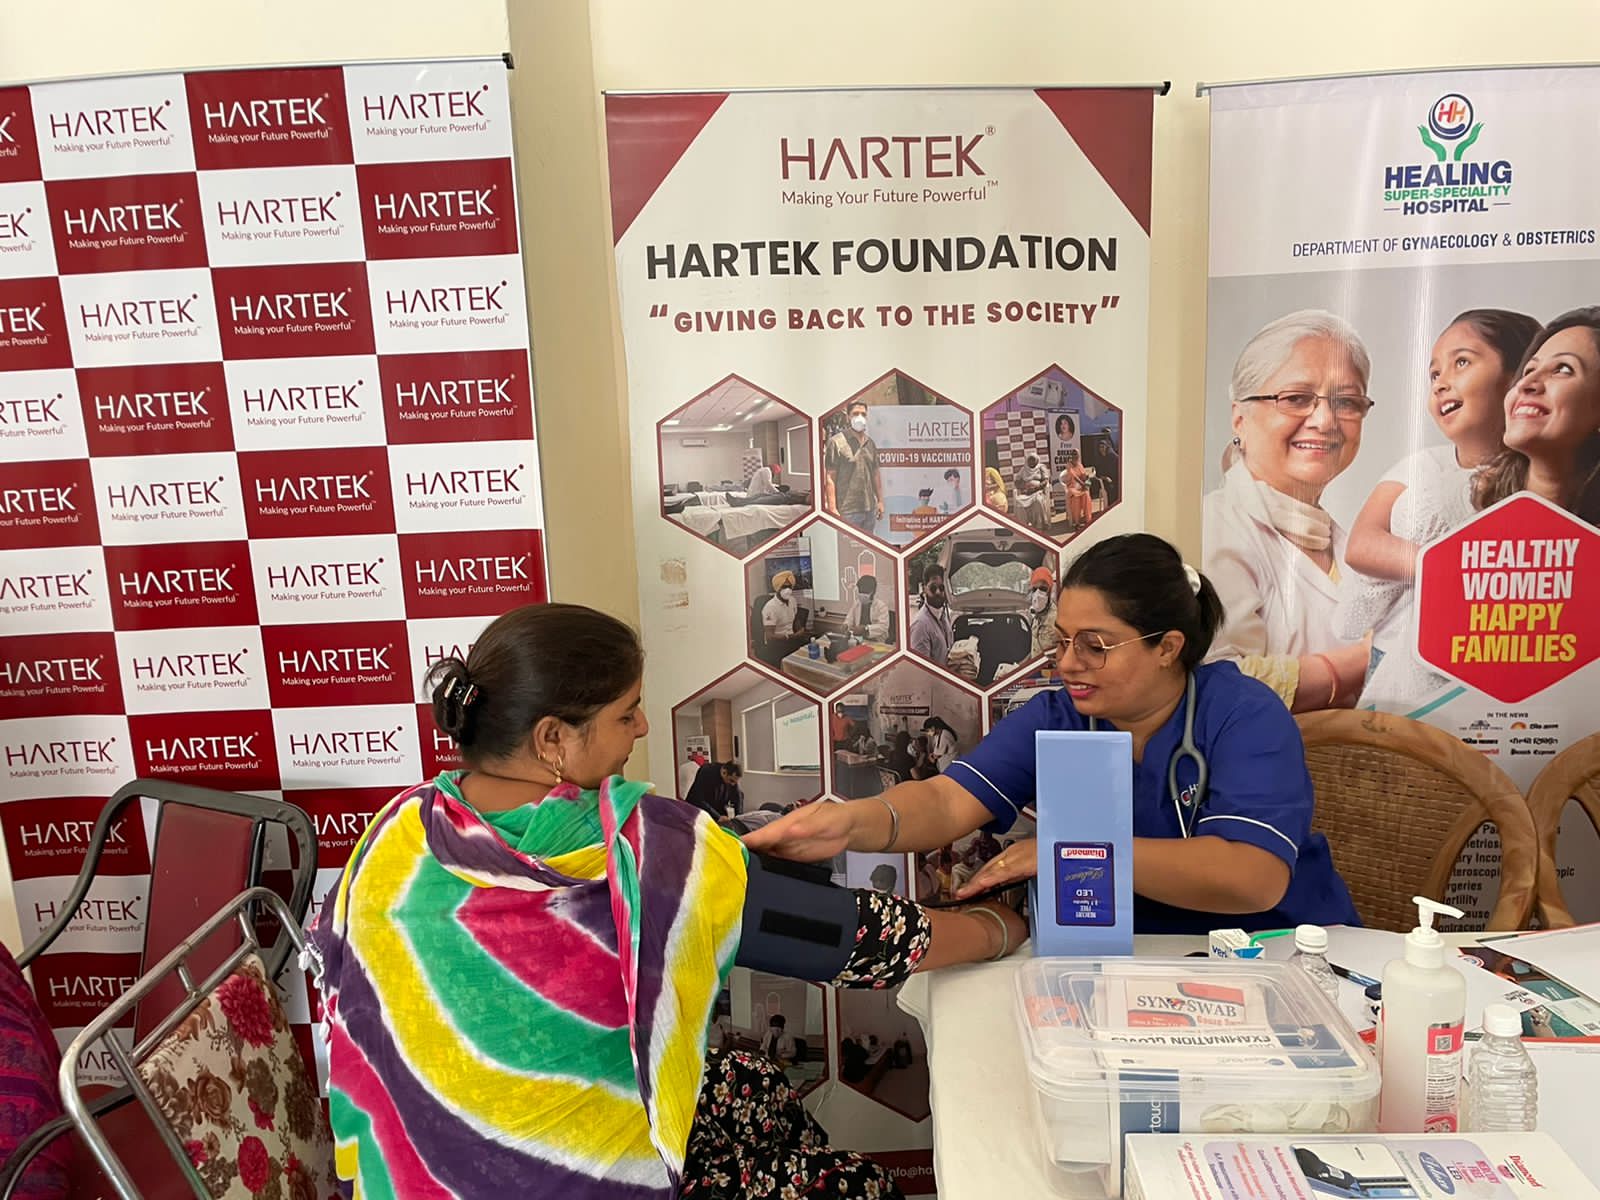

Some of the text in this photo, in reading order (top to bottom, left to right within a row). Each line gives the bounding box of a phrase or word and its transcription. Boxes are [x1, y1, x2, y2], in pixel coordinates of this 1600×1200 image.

[204, 95, 327, 128] HARTEK
[364, 86, 487, 120] HARTEK
[50, 101, 169, 138] HARTEK
[1385, 160, 1512, 189] HEALING
[375, 186, 495, 219] HARTEK
[782, 191, 833, 208] Making
[837, 191, 869, 205] Your
[873, 189, 919, 203] Future
[1384, 185, 1511, 201] SUPER-SPECIALITY
[1403, 199, 1489, 215] HOSPITAL
[64, 200, 182, 234] HARTEK
[218, 193, 340, 225] HARTEK
[647, 235, 1117, 279] HARTEK FOUNDATION
[1293, 229, 1595, 257] DEPARTMENT OF GYNAECOLOGY & OBSTETRICS
[81, 295, 196, 328] HARTEK
[231, 289, 350, 320] HARTEK
[387, 282, 506, 313] HARTEK
[788, 307, 865, 330] BACK
[876, 305, 913, 327] TO
[923, 304, 976, 326] THE
[96, 388, 208, 419] HARTEK
[244, 381, 362, 412] HARTEK
[396, 375, 513, 406] HARTEK
[908, 421, 969, 437] HARTEK
[879, 452, 919, 463] COVID-19
[108, 477, 222, 508] HARTEK
[256, 472, 372, 501] HARTEK
[407, 465, 522, 495] HARTEK
[416, 554, 529, 582] HARTEK
[1461, 538, 1580, 569] HEALTHY
[120, 565, 234, 595] HARTEK
[268, 559, 382, 588] HARTEK
[1462, 571, 1573, 600] WOMEN
[1470, 602, 1564, 631] HAPPY
[279, 645, 391, 673] HARTEK
[1450, 633, 1577, 663] FAMILIES
[133, 650, 246, 678] HARTEK
[6, 738, 114, 766] HARTEK
[146, 733, 256, 760] HARTEK
[290, 727, 401, 755] HARTEK
[19, 821, 127, 846] HARTK
[35, 898, 140, 922] HRTEK
[49, 976, 138, 997] HARTE
